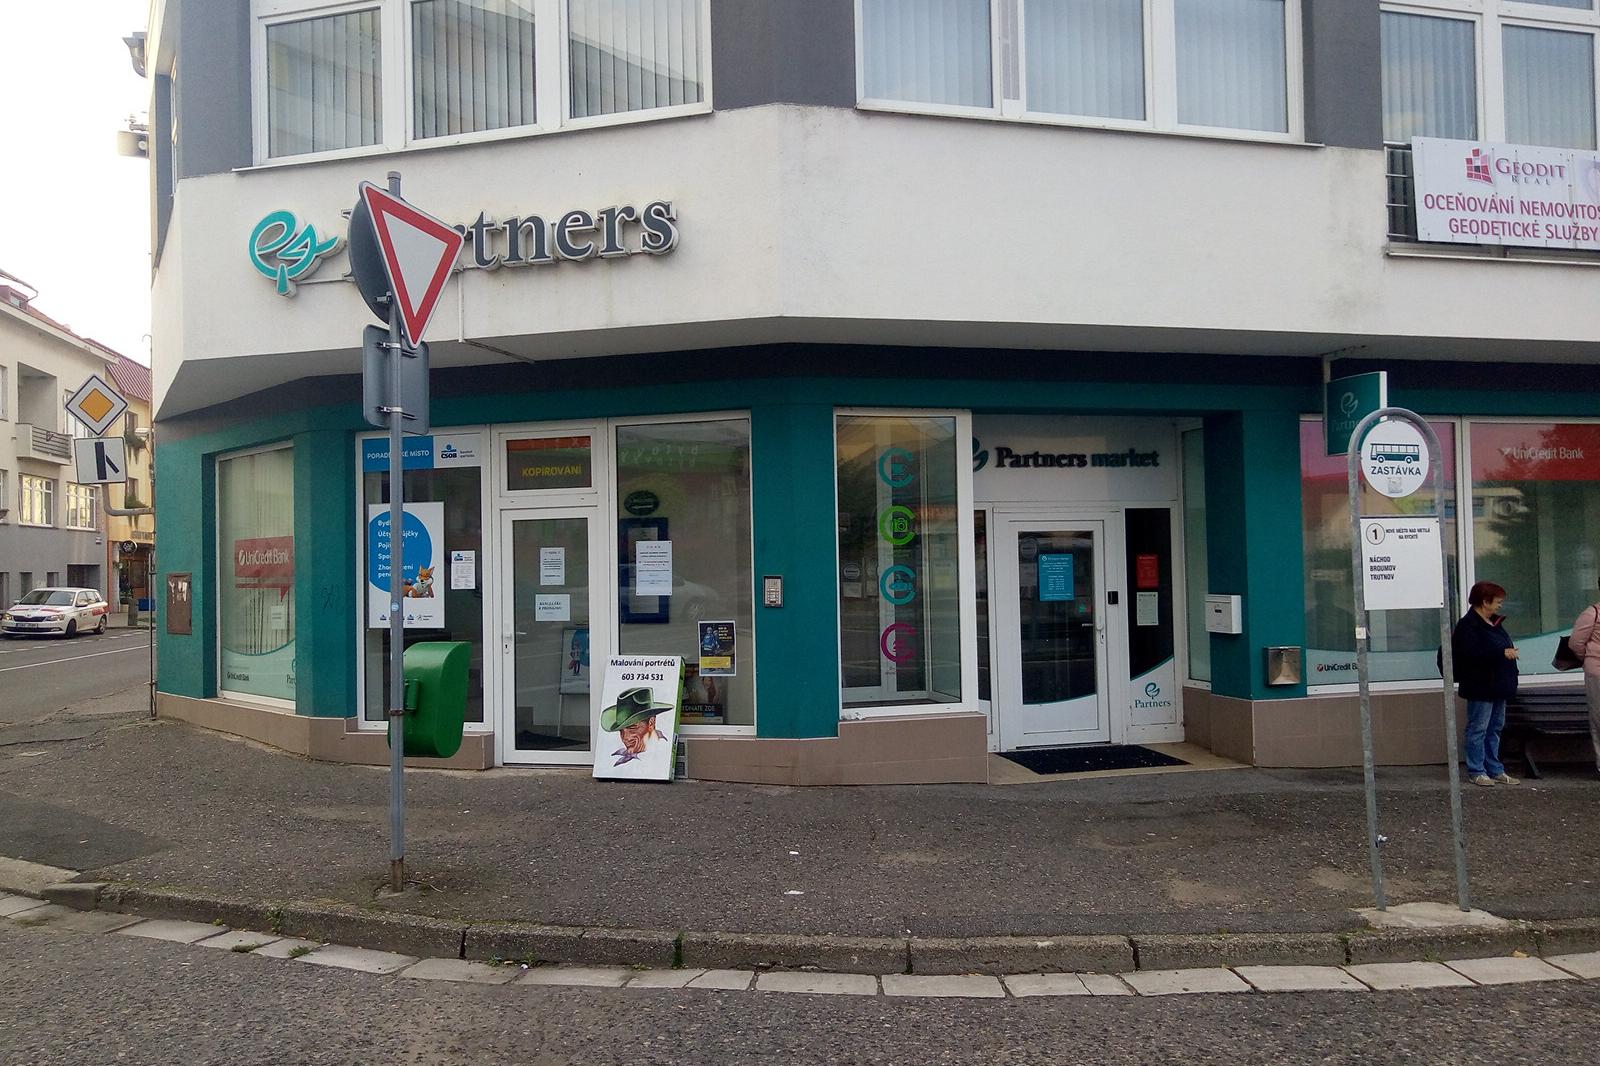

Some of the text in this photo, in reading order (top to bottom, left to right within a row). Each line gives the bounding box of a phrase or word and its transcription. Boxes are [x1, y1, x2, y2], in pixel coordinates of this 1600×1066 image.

[1423, 191, 1515, 215] OCEŇOVÁNÍ
[1448, 217, 1599, 242] GEODETICKÉ SLUŽBY
[995, 446, 1159, 468] Partners market
[1513, 447, 1584, 459] UniCredit Bank
[1370, 464, 1421, 475] ZASTÁVKA
[1372, 528, 1378, 540] 1
[246, 548, 289, 566] UniCredit Bank
[1135, 699, 1171, 708] Partners
